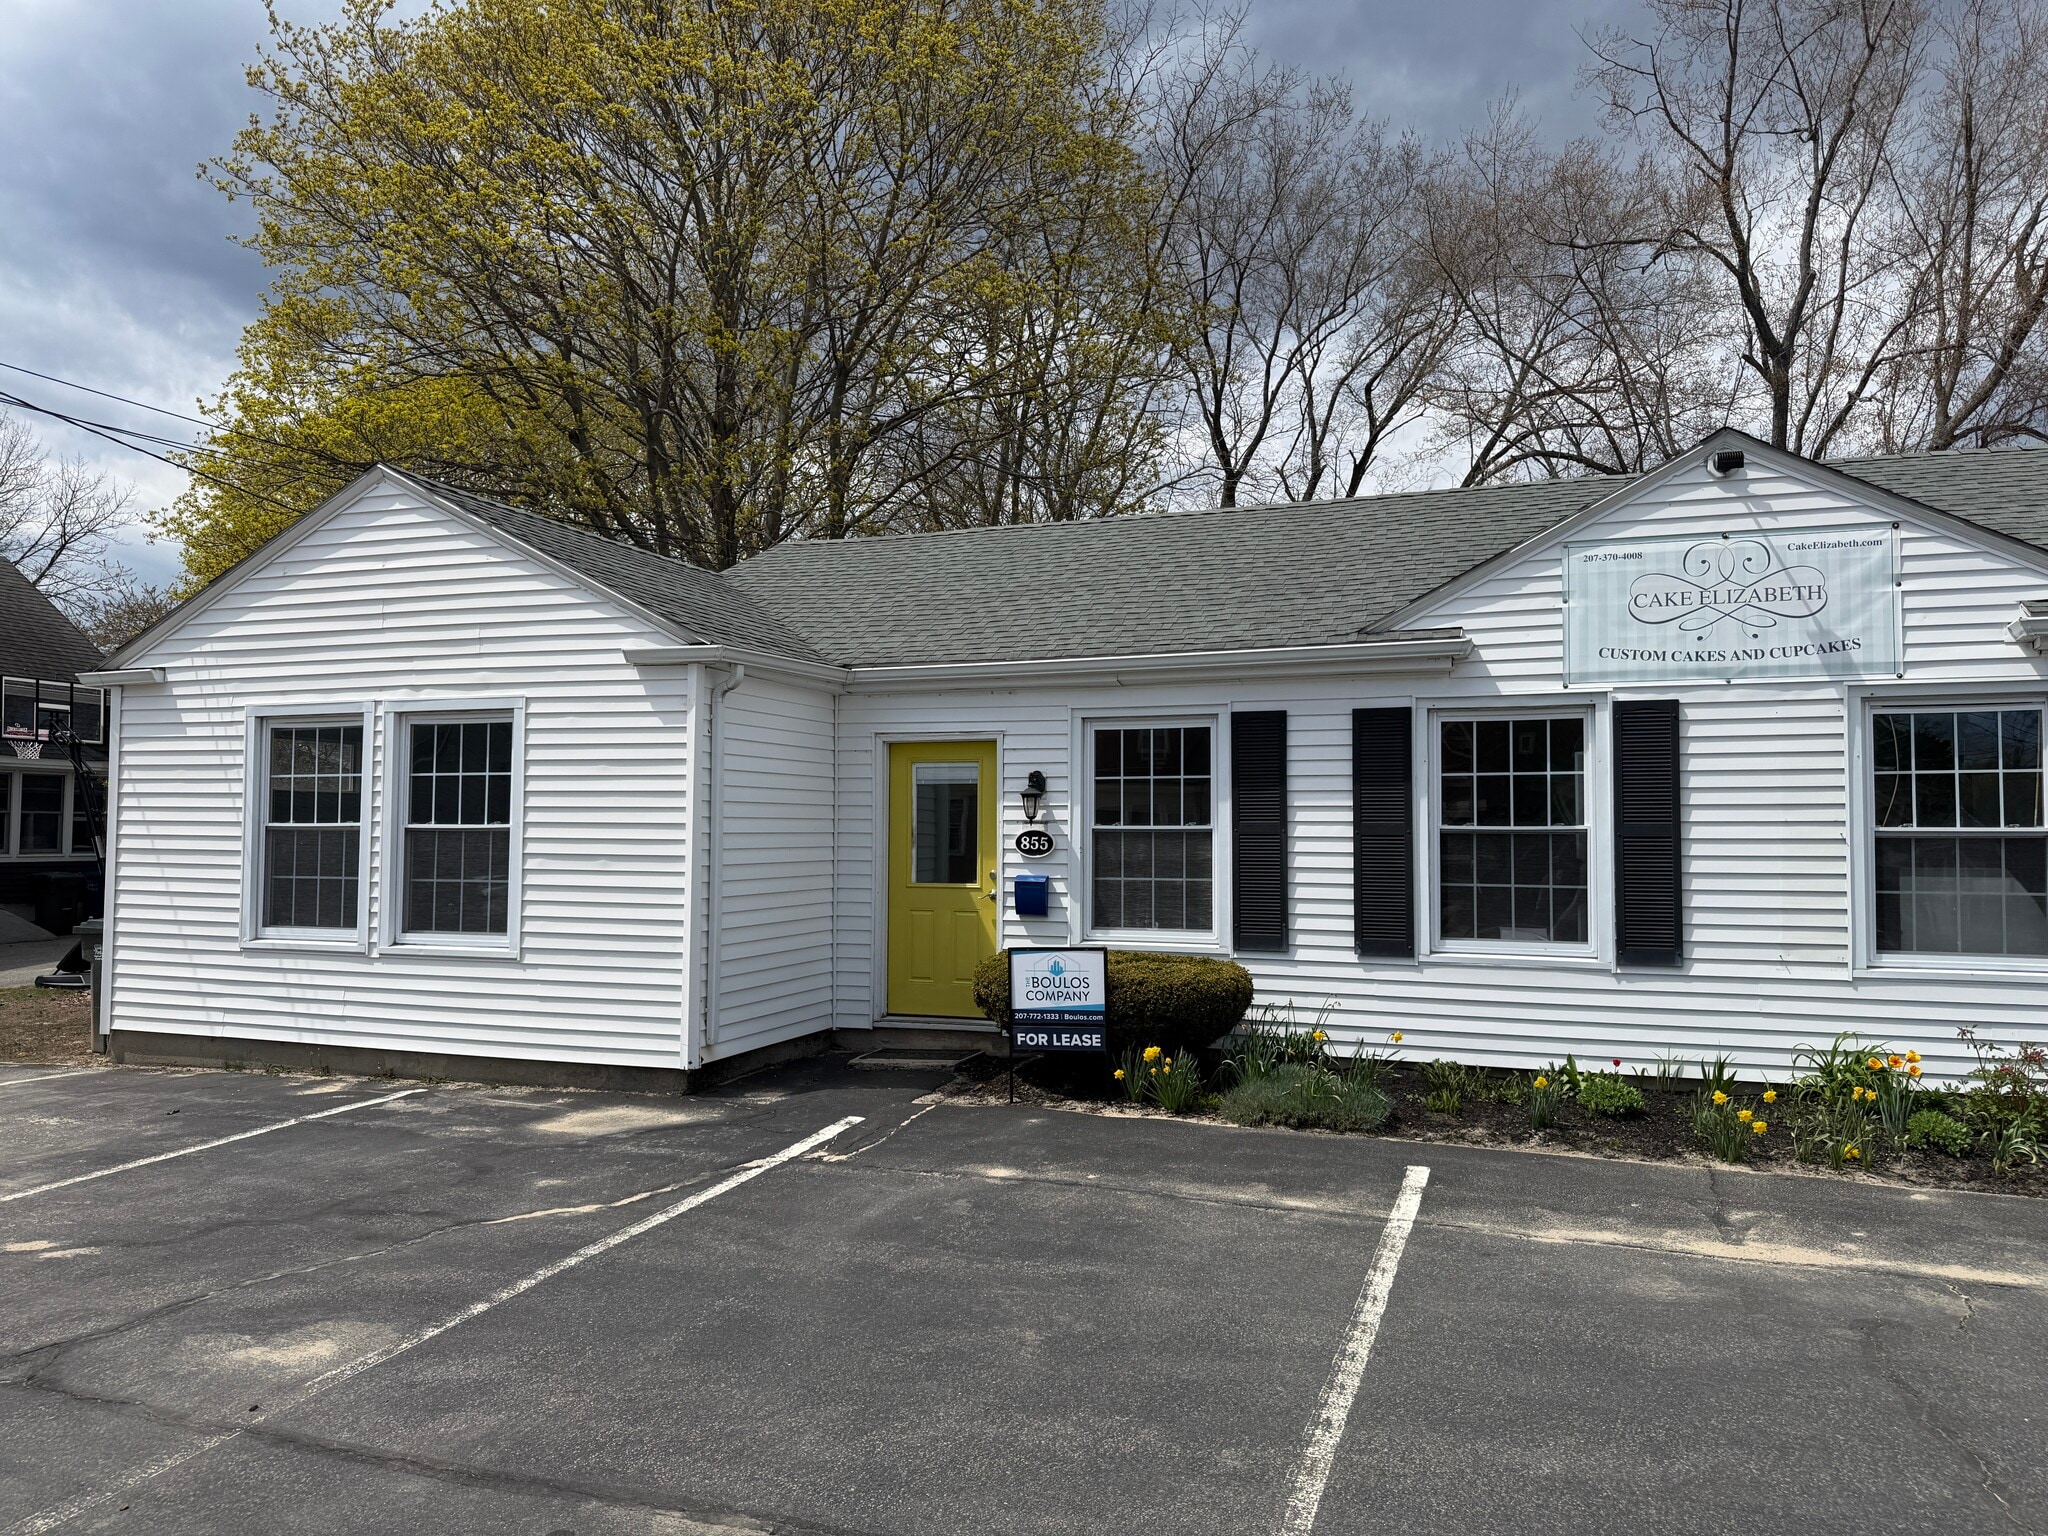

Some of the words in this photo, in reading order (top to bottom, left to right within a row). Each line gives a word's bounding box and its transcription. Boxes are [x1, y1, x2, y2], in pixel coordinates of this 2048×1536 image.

[1787, 539, 1883, 551] CakeElizabeth.com
[1583, 552, 1643, 563] 207-370-4008
[1633, 591, 1693, 608] CAKE
[1699, 585, 1823, 605] ELIZABETH
[1598, 647, 1666, 662] CUSTOM
[1671, 650, 1726, 662] CAKES
[1730, 648, 1765, 661] AND
[1769, 637, 1861, 659] CUPCAKES
[1020, 835, 1049, 850] 855
[1031, 976, 1090, 989] BOULOS
[1025, 990, 1090, 1002] COMPANY
[1014, 1012, 1060, 1020] 207-772-1333
[1064, 1013, 1104, 1021] Boulos.com
[1016, 1033, 1048, 1046] FOR
[1053, 1033, 1102, 1047] LEASE
